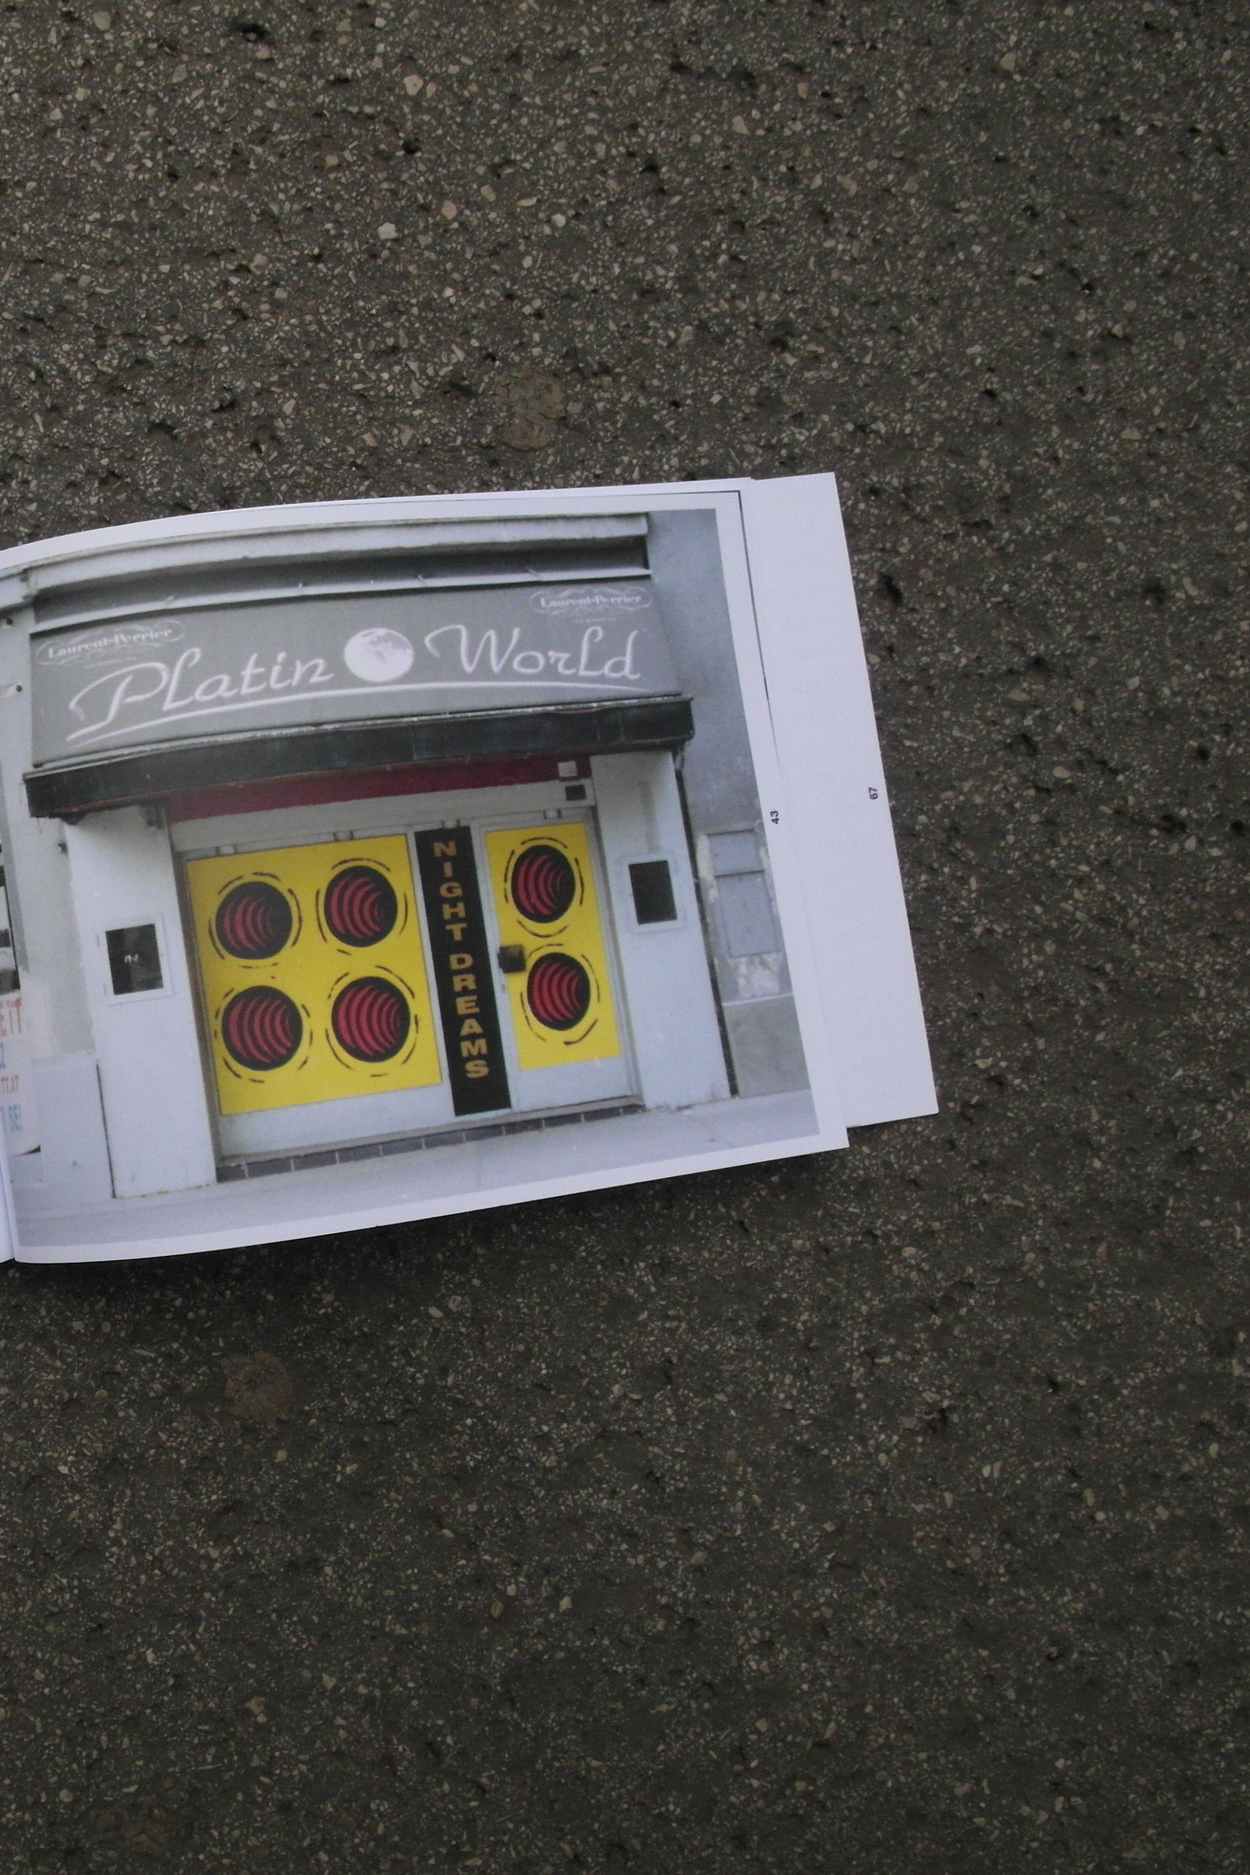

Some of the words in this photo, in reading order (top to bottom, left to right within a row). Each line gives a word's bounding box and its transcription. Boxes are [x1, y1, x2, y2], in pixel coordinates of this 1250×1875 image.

[770, 810, 780, 825] 43
[868, 786, 879, 800] 67
[433, 840, 468, 942] NIGHT
[449, 952, 491, 1079] DREAMS
